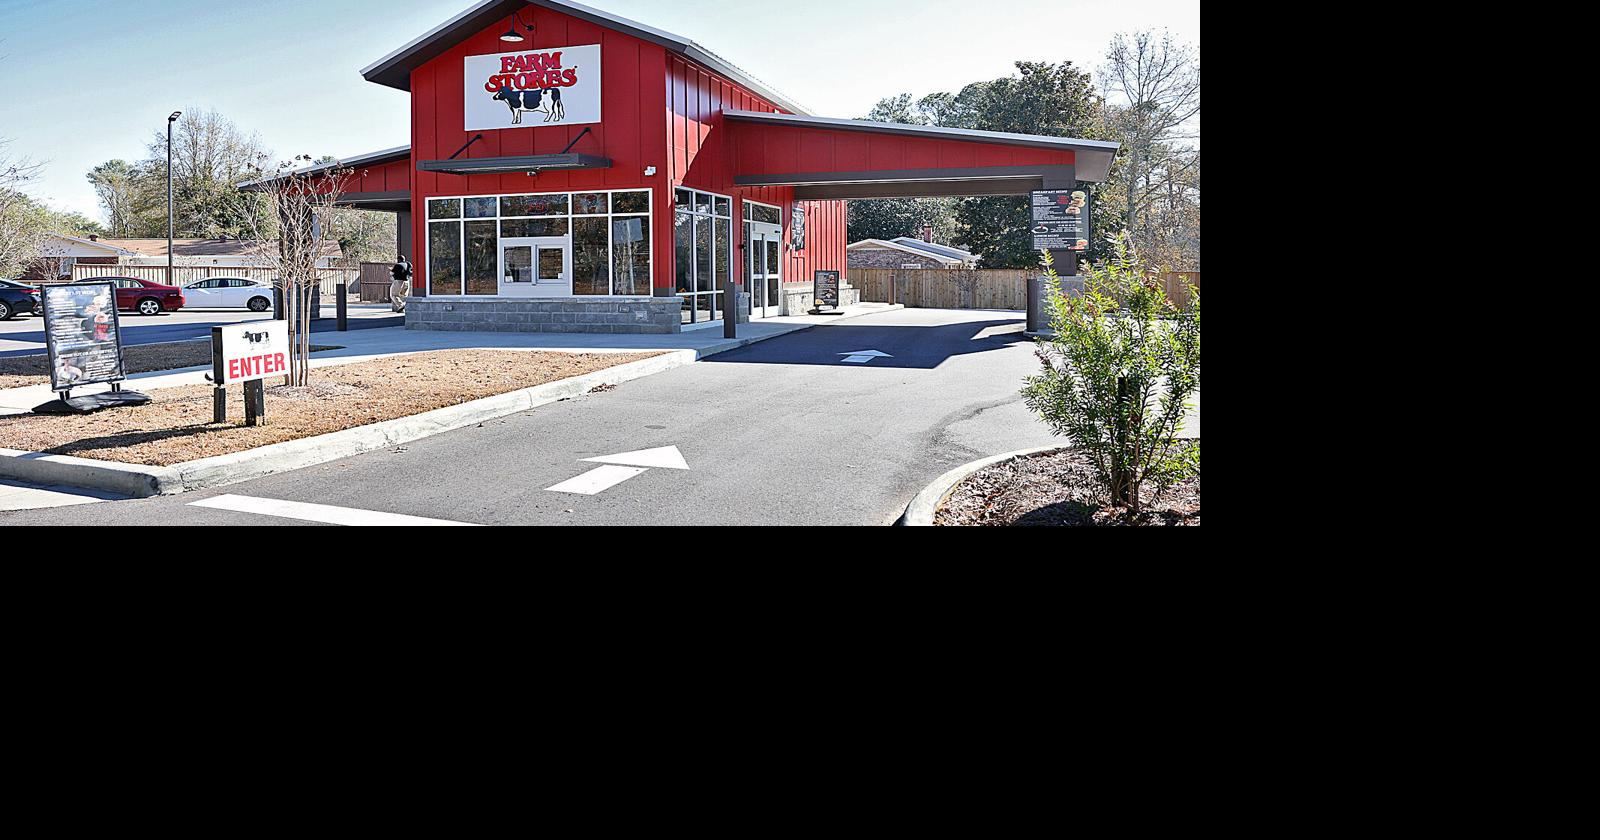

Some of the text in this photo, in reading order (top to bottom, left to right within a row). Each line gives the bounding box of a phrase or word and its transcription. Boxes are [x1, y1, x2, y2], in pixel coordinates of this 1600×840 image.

[500, 52, 562, 73] FARM
[485, 68, 577, 92] STORES
[229, 352, 285, 379] ENTER
